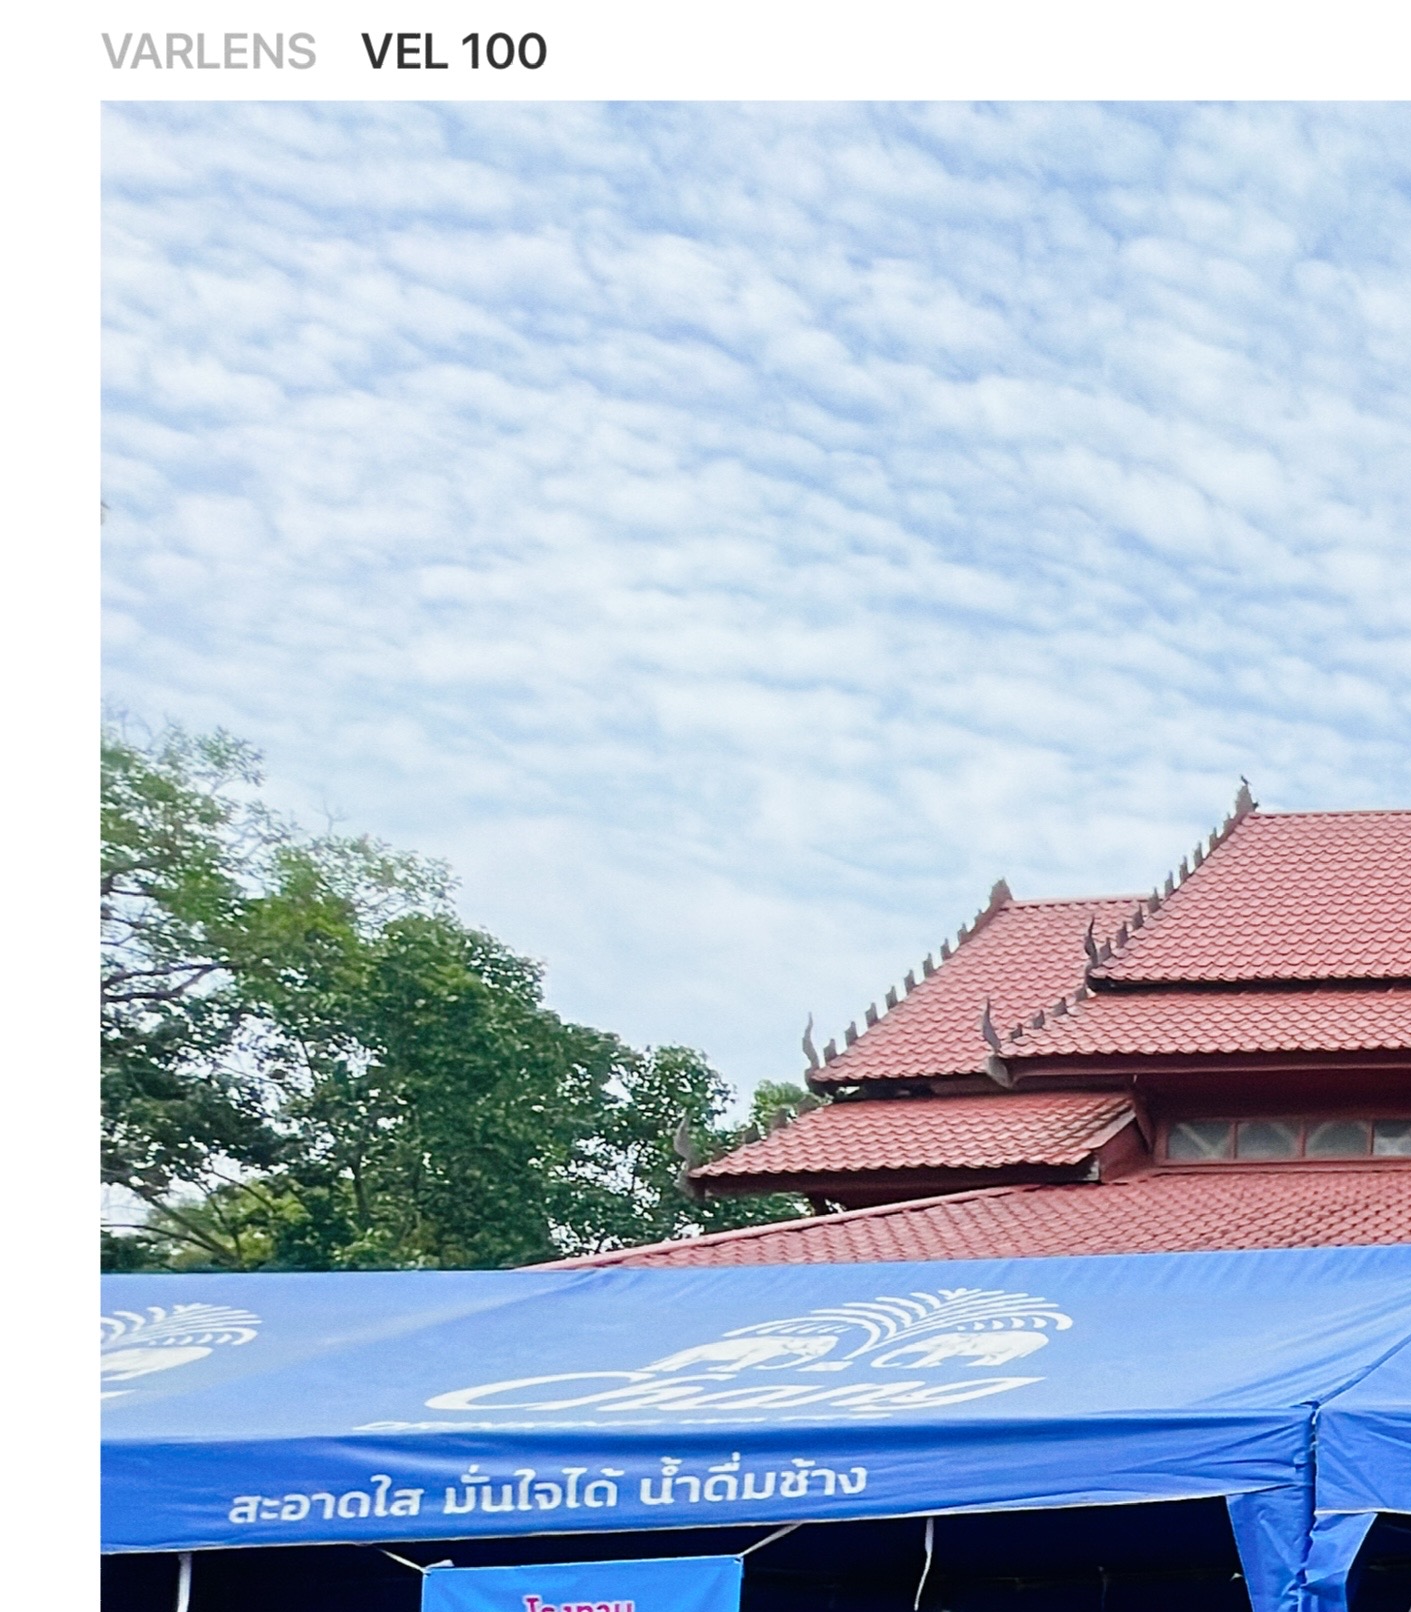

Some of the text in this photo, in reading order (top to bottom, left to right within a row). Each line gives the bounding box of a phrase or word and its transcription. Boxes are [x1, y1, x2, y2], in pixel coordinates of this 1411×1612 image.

[229, 1452, 869, 1524] สะอาดใส มั่นใจได้ น้ำดื่มช้าง
